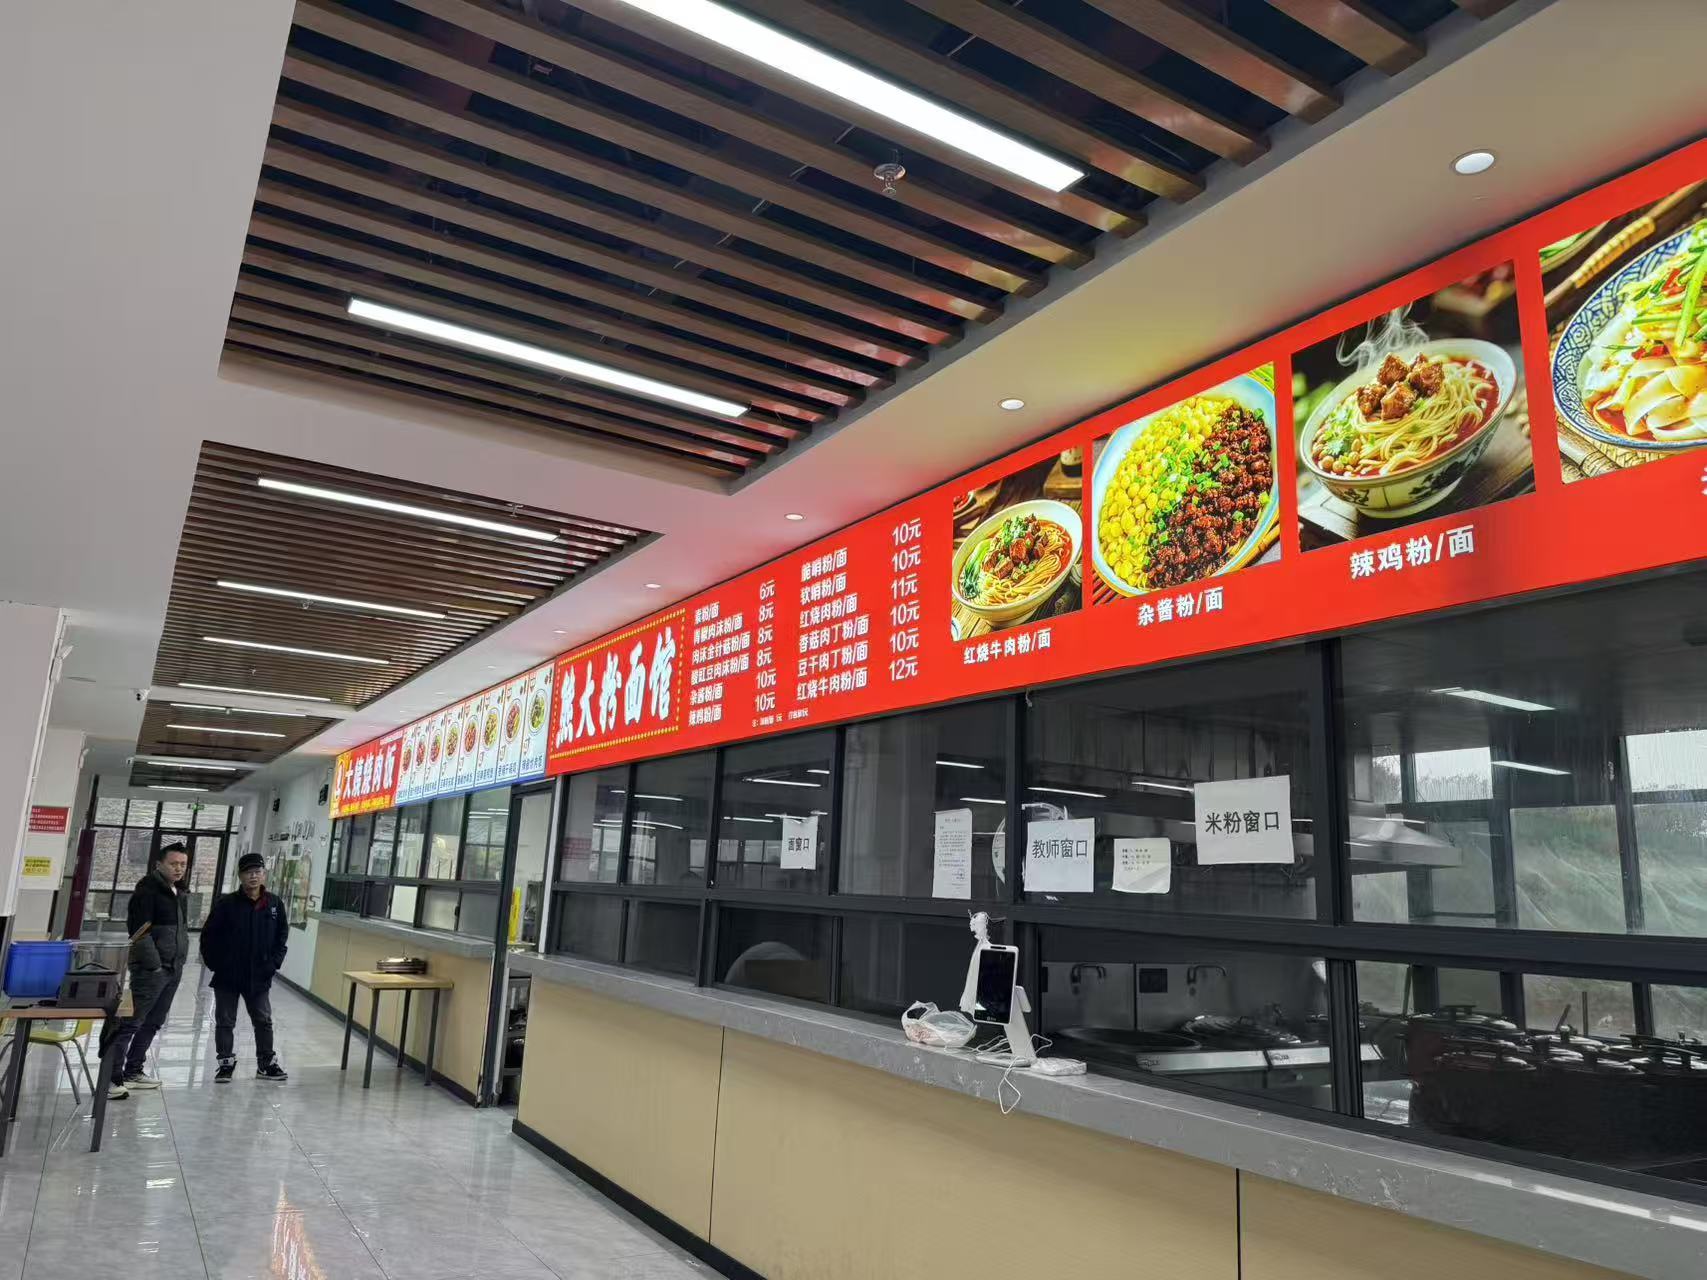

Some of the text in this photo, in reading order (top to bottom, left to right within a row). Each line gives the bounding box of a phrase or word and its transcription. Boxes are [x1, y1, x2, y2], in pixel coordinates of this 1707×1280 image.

[892, 519, 921, 545] 10元
[892, 546, 920, 572] 10元
[1350, 524, 1475, 580] 辣鸡粉/面
[760, 580, 774, 600] 6元
[800, 574, 917, 627] 红烧肉粉/面 11元
[759, 603, 773, 621] 8元
[1137, 586, 1225, 626] 杂酱粉/面
[758, 625, 772, 643] 8元
[799, 601, 919, 652] 香菇肉丁粉/面 10元
[757, 648, 771, 666] 8元
[798, 628, 918, 676] 豆干肉丁粉/面 10元
[963, 627, 1052, 665] 红烧牛肉粉/面
[757, 669, 775, 689] 10元
[797, 656, 917, 700] 红烧牛肉粉/面 12元
[755, 692, 775, 712] 10元
[1205, 810, 1280, 835] 米粉窗口
[1032, 839, 1088, 859] 教师窗口
